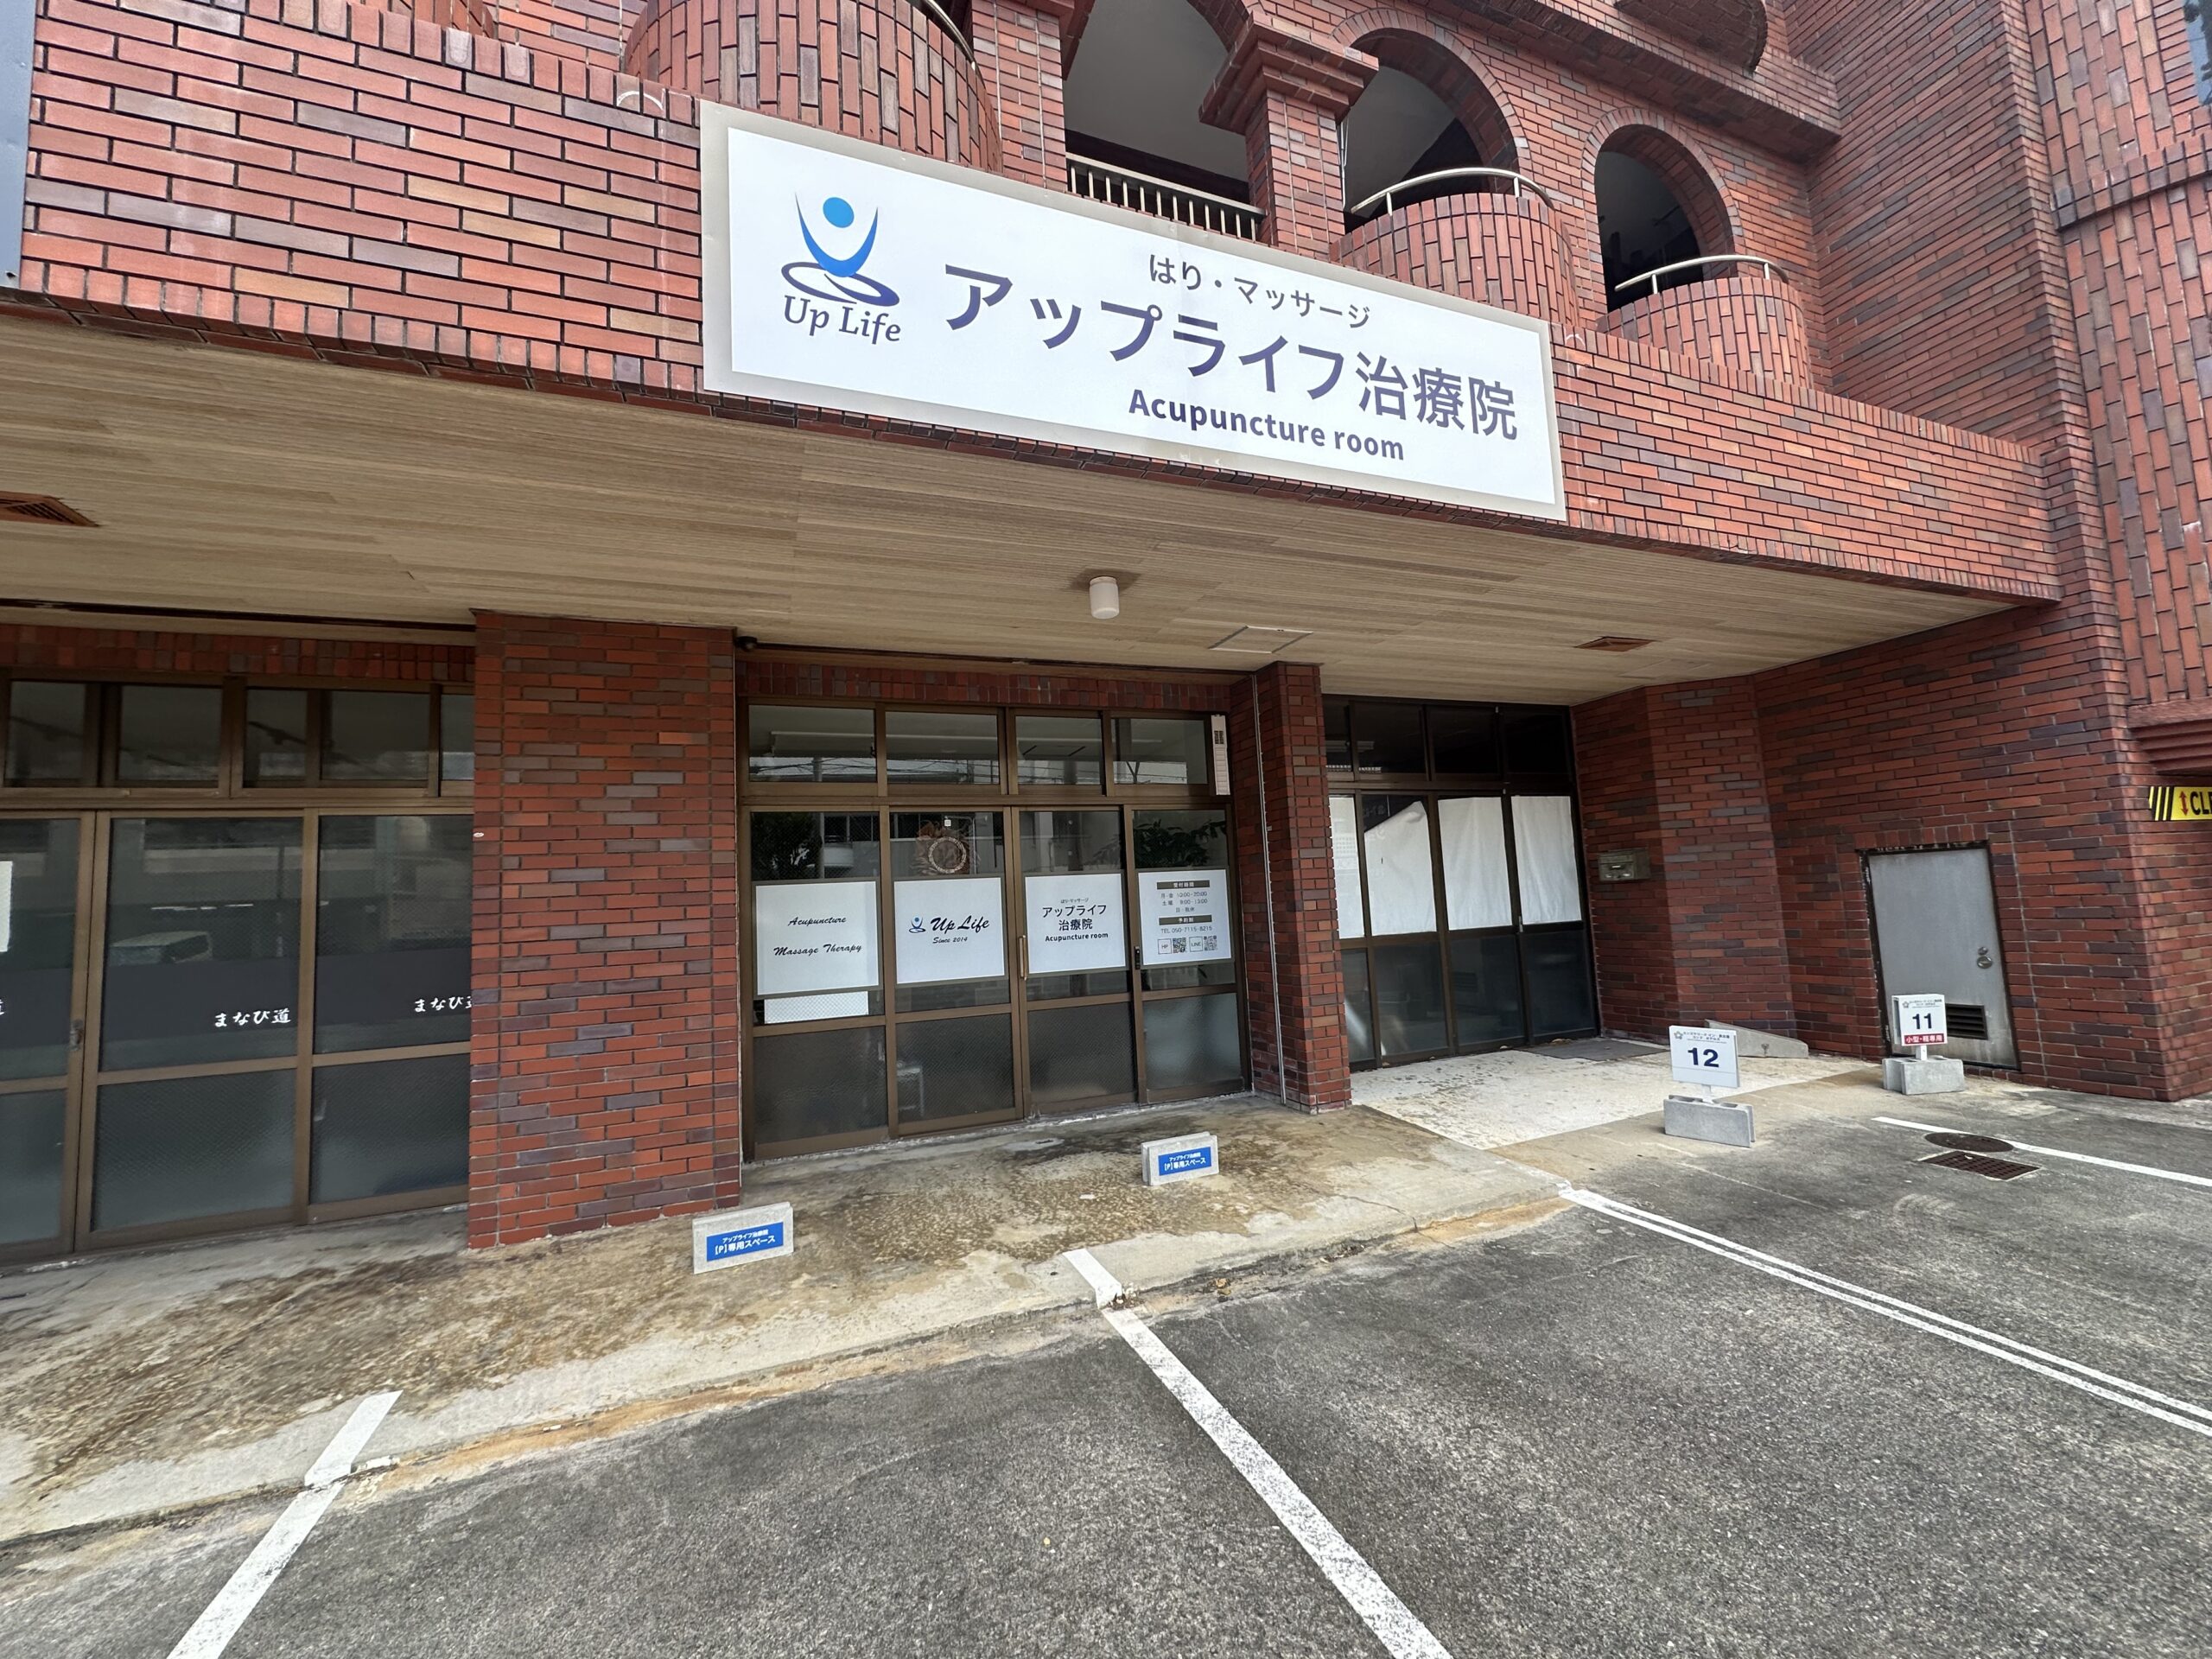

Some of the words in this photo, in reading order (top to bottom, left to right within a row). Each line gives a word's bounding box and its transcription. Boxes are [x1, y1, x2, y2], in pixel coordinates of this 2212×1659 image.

[1149, 254, 1370, 328] はり・マッサージ
[784, 295, 830, 337] Up
[838, 305, 901, 346] Life
[944, 263, 1518, 441] アップライフ治療院
[1128, 389, 1325, 447] Acupuncture
[1335, 431, 1404, 461] room
[1042, 904, 1107, 918] アップライフ
[787, 916, 847, 927] Acupuncture
[930, 916, 957, 932] Up
[957, 914, 990, 934] Life
[1058, 918, 1093, 931] 治療院
[931, 936, 951, 944] Since
[1045, 934, 1090, 943] Acupuncture
[773, 945, 819, 957] Massage
[822, 943, 862, 956] Therapy
[213, 1007, 292, 1028] まなび道
[1911, 1013, 1932, 1030] 11
[1687, 1046, 1719, 1068] 12
[1168, 1151, 1201, 1163] アップライフ治療院
[721, 1229, 769, 1244] アップライフ治療院
